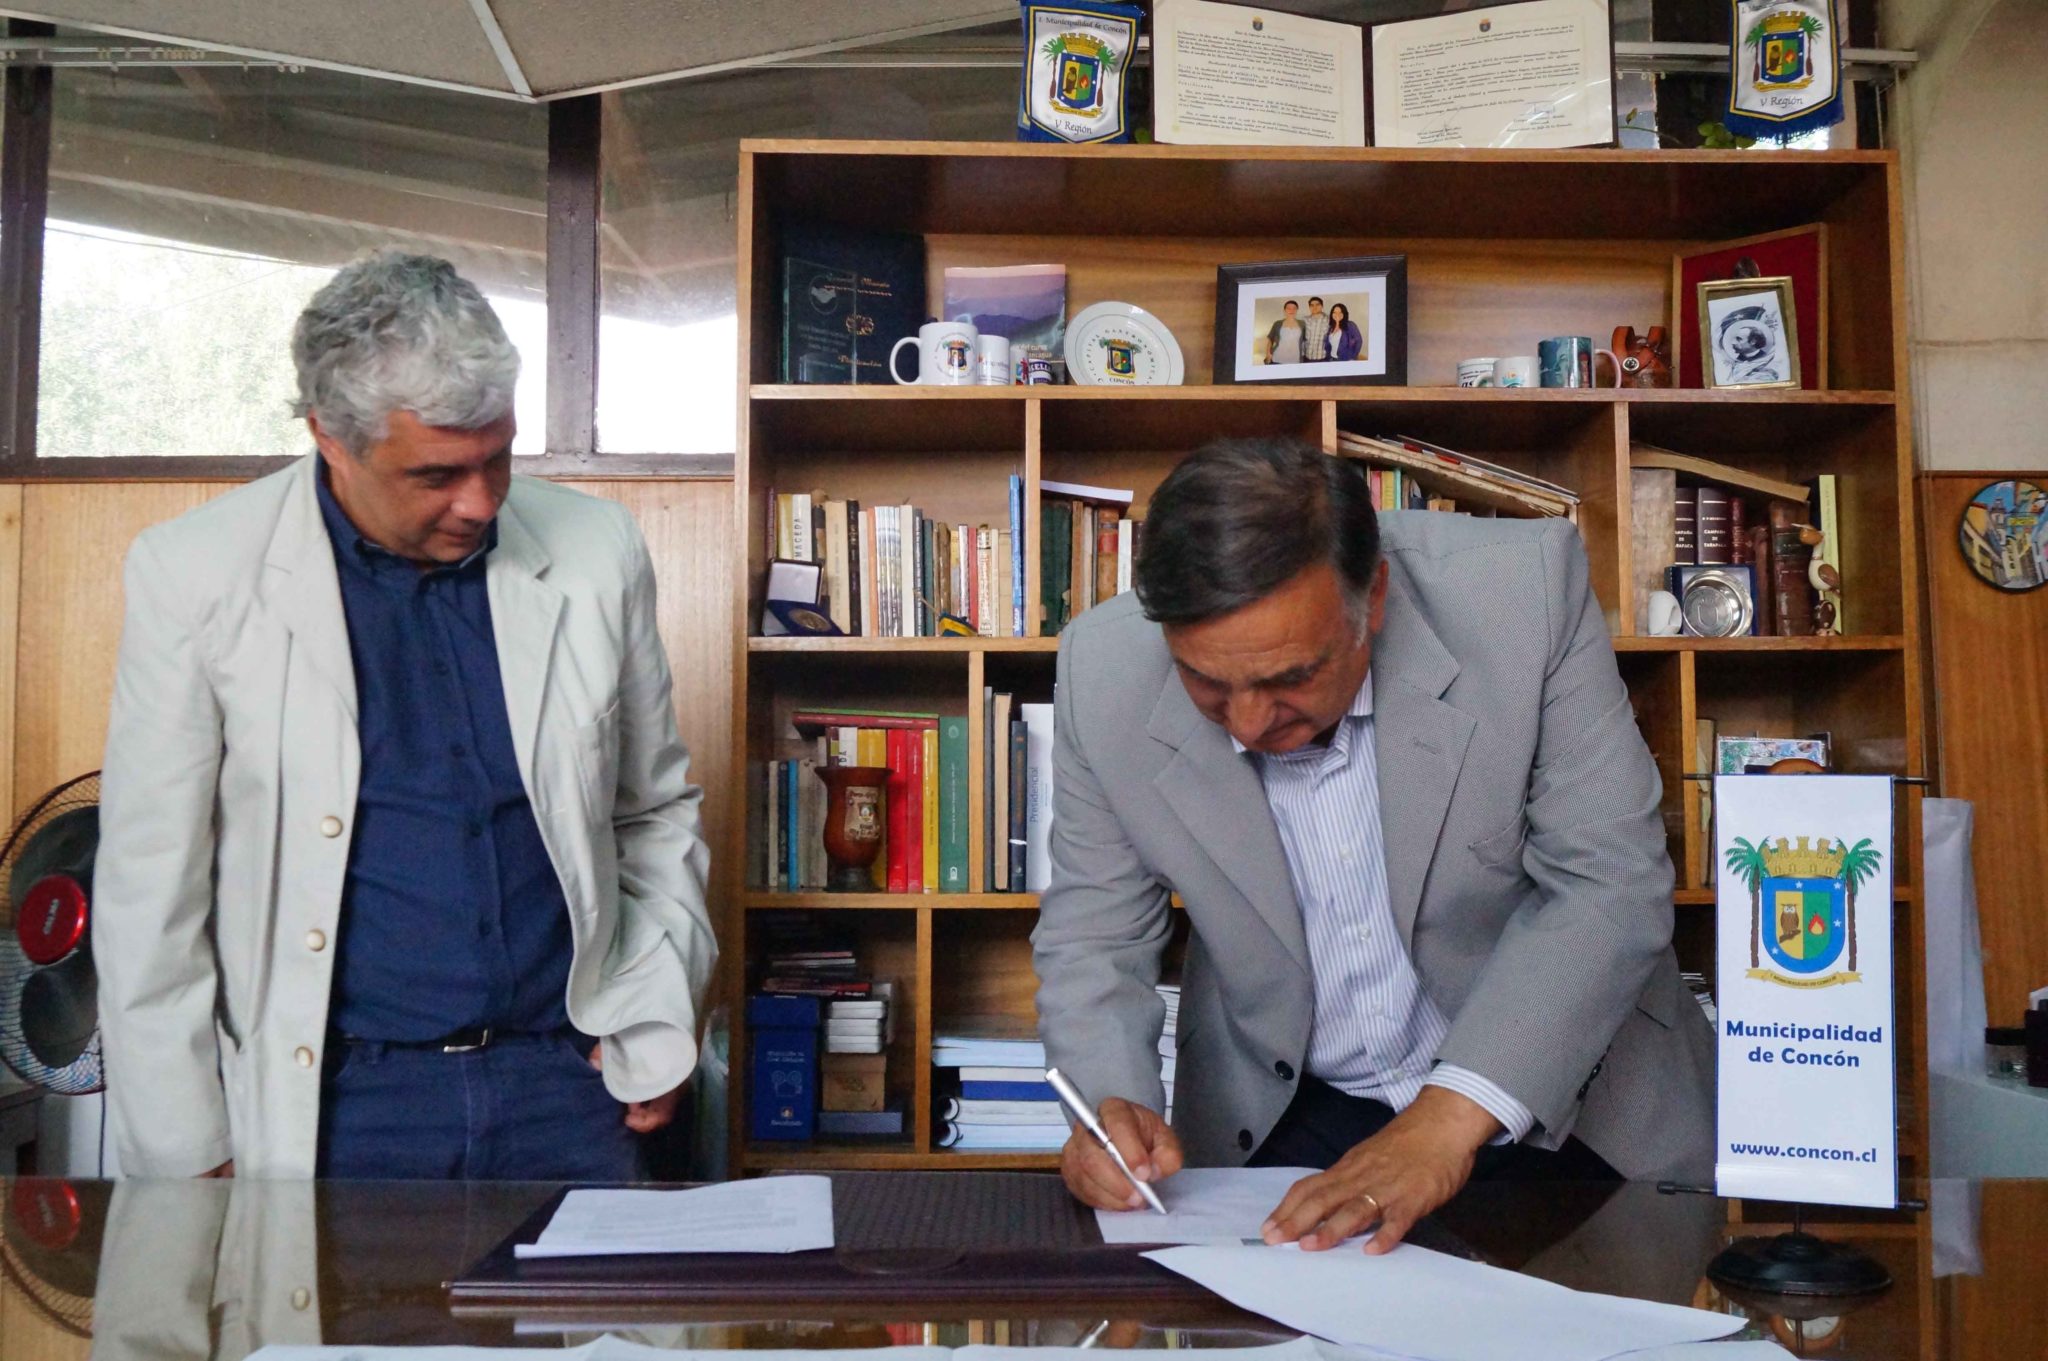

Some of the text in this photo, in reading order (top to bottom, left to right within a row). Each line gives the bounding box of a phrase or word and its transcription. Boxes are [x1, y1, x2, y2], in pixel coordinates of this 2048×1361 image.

[1046, 17, 1092, 28] Municipalidad
[1760, 97, 1803, 108] V Región
[1055, 119, 1092, 136] V Región
[1029, 766, 1039, 824] Presidencial
[1727, 1021, 1881, 1043] Municipalidad
[1748, 1047, 1859, 1067] de Concón
[1731, 1144, 1876, 1162] www.concon.cl
